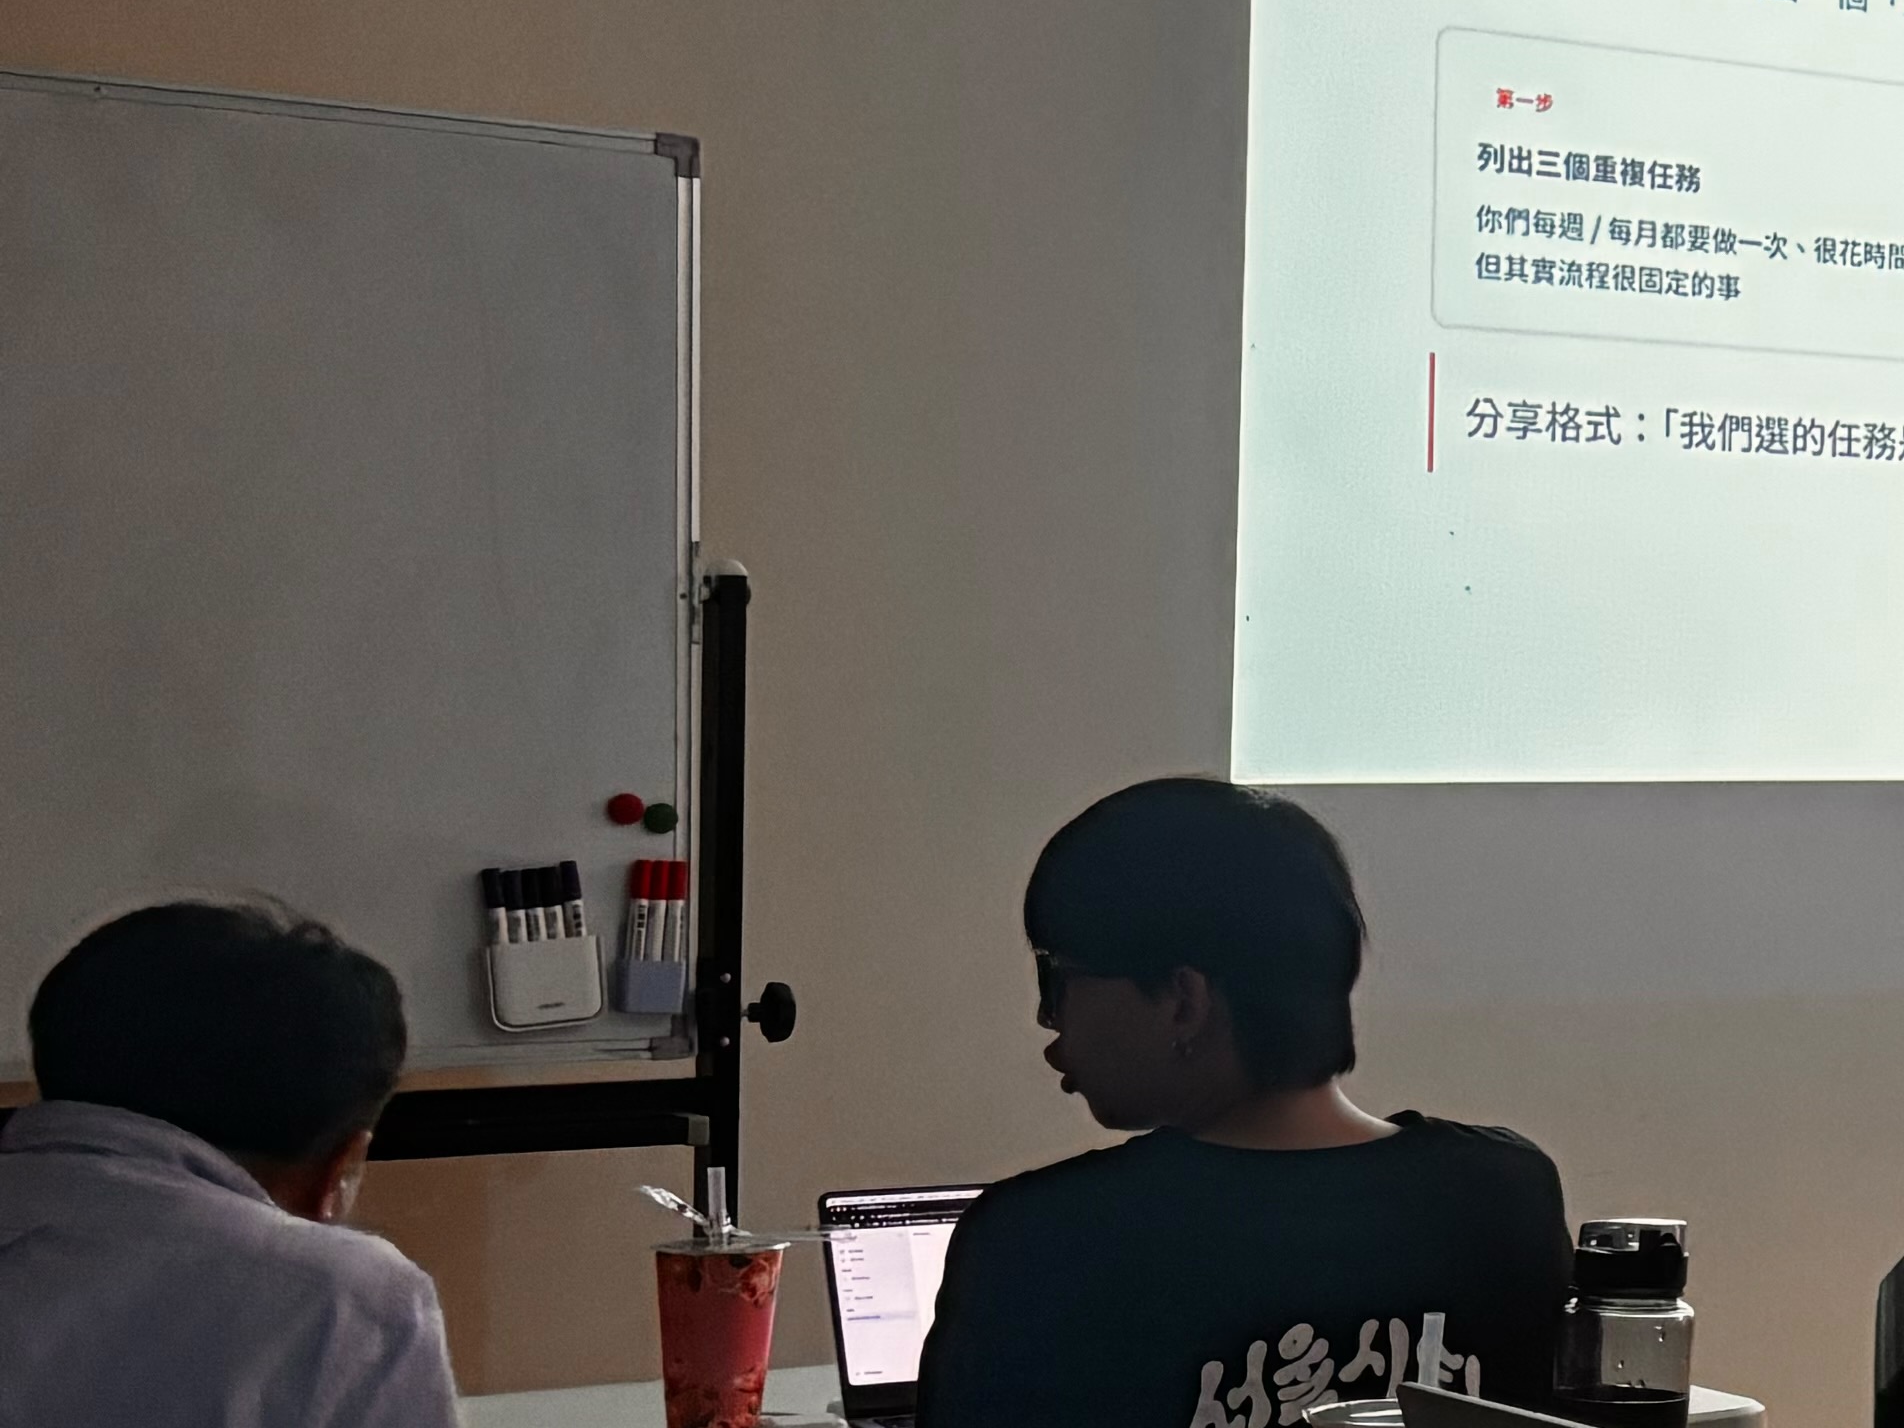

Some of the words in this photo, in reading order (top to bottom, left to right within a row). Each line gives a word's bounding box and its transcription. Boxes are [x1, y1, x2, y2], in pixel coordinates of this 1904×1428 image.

[1496, 87, 1554, 113] 第一步
[1476, 142, 1702, 194] 列出三個重複任務
[1475, 252, 1741, 301] 但其實流程很固定的事
